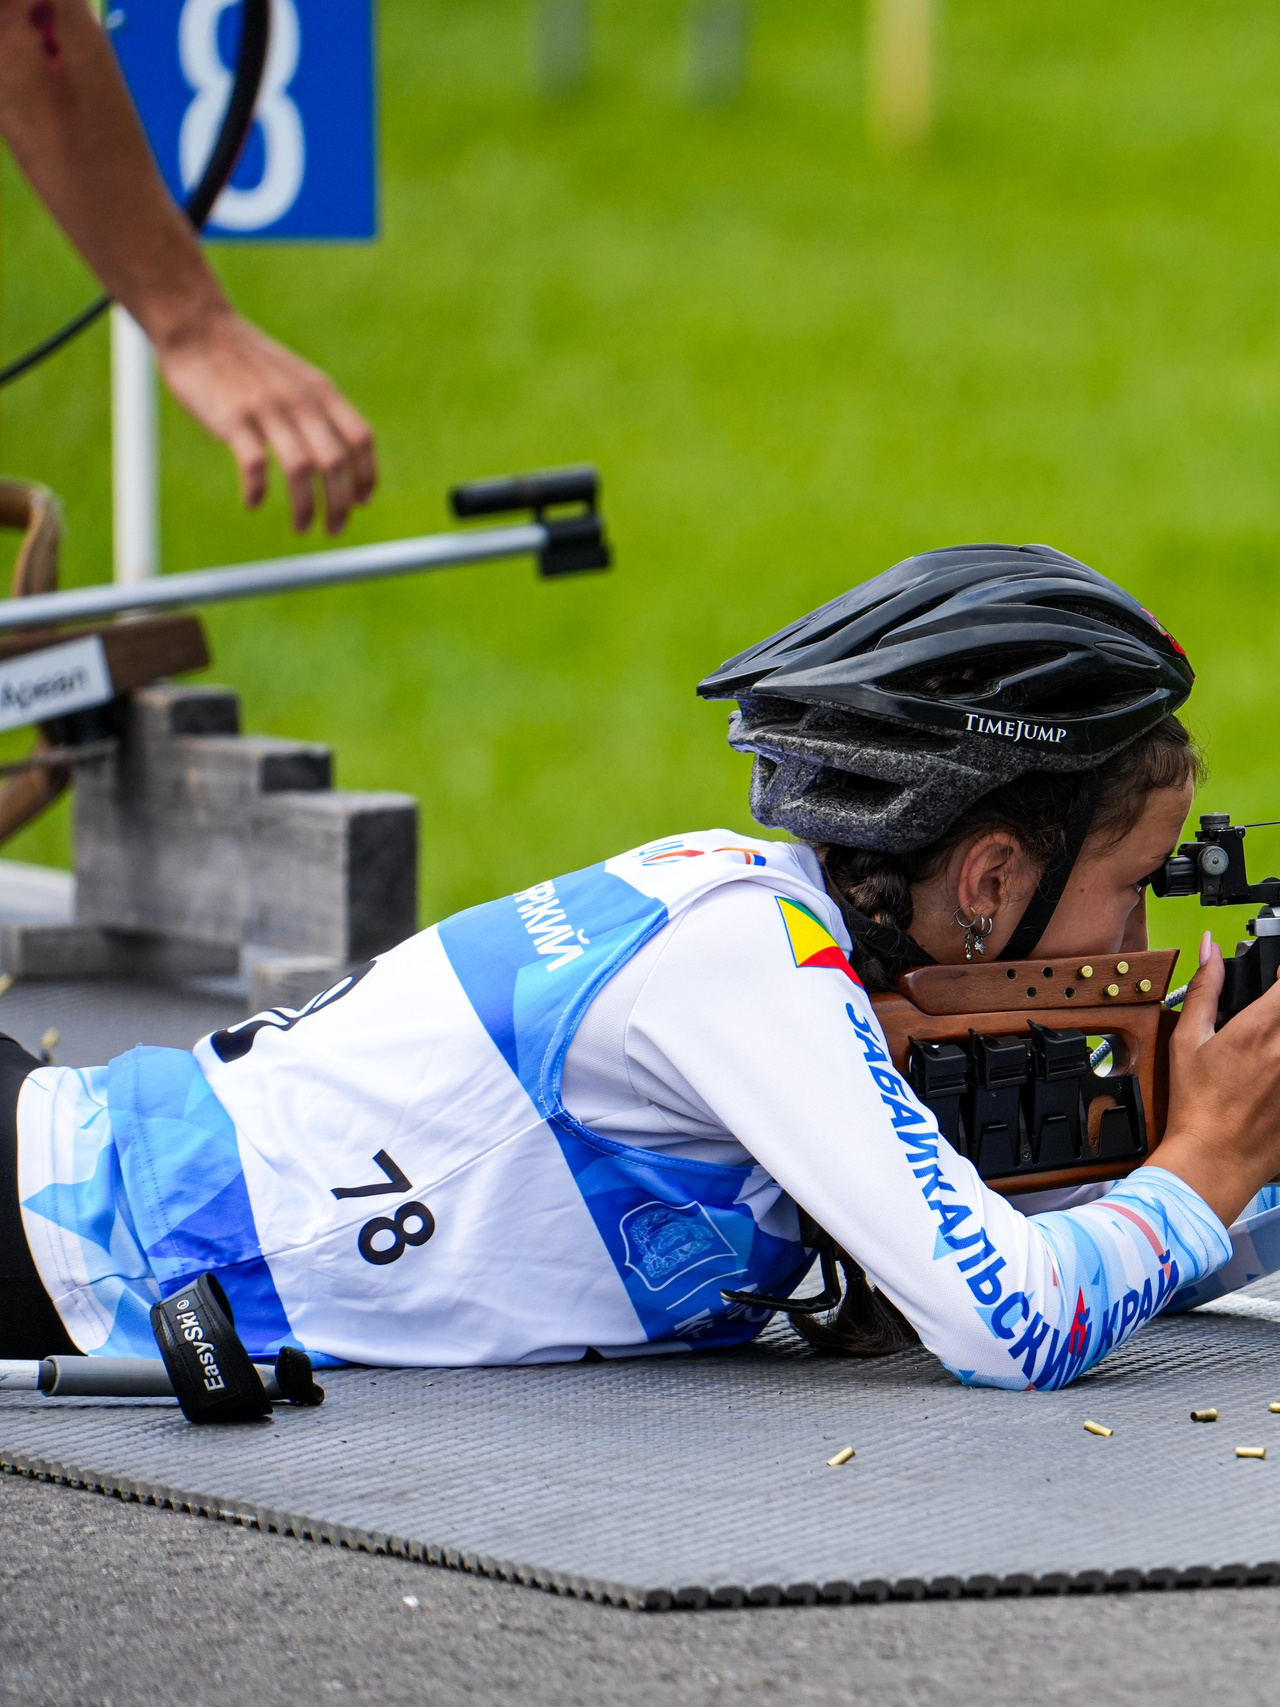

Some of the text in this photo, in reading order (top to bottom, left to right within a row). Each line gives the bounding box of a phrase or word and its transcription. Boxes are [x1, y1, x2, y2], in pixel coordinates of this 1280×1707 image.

[178, 0, 305, 231] 8
[330, 1148, 437, 1267] 78
[176, 1311, 225, 1393] EasySki
[1094, 1248, 1181, 1364] КРАЙ
